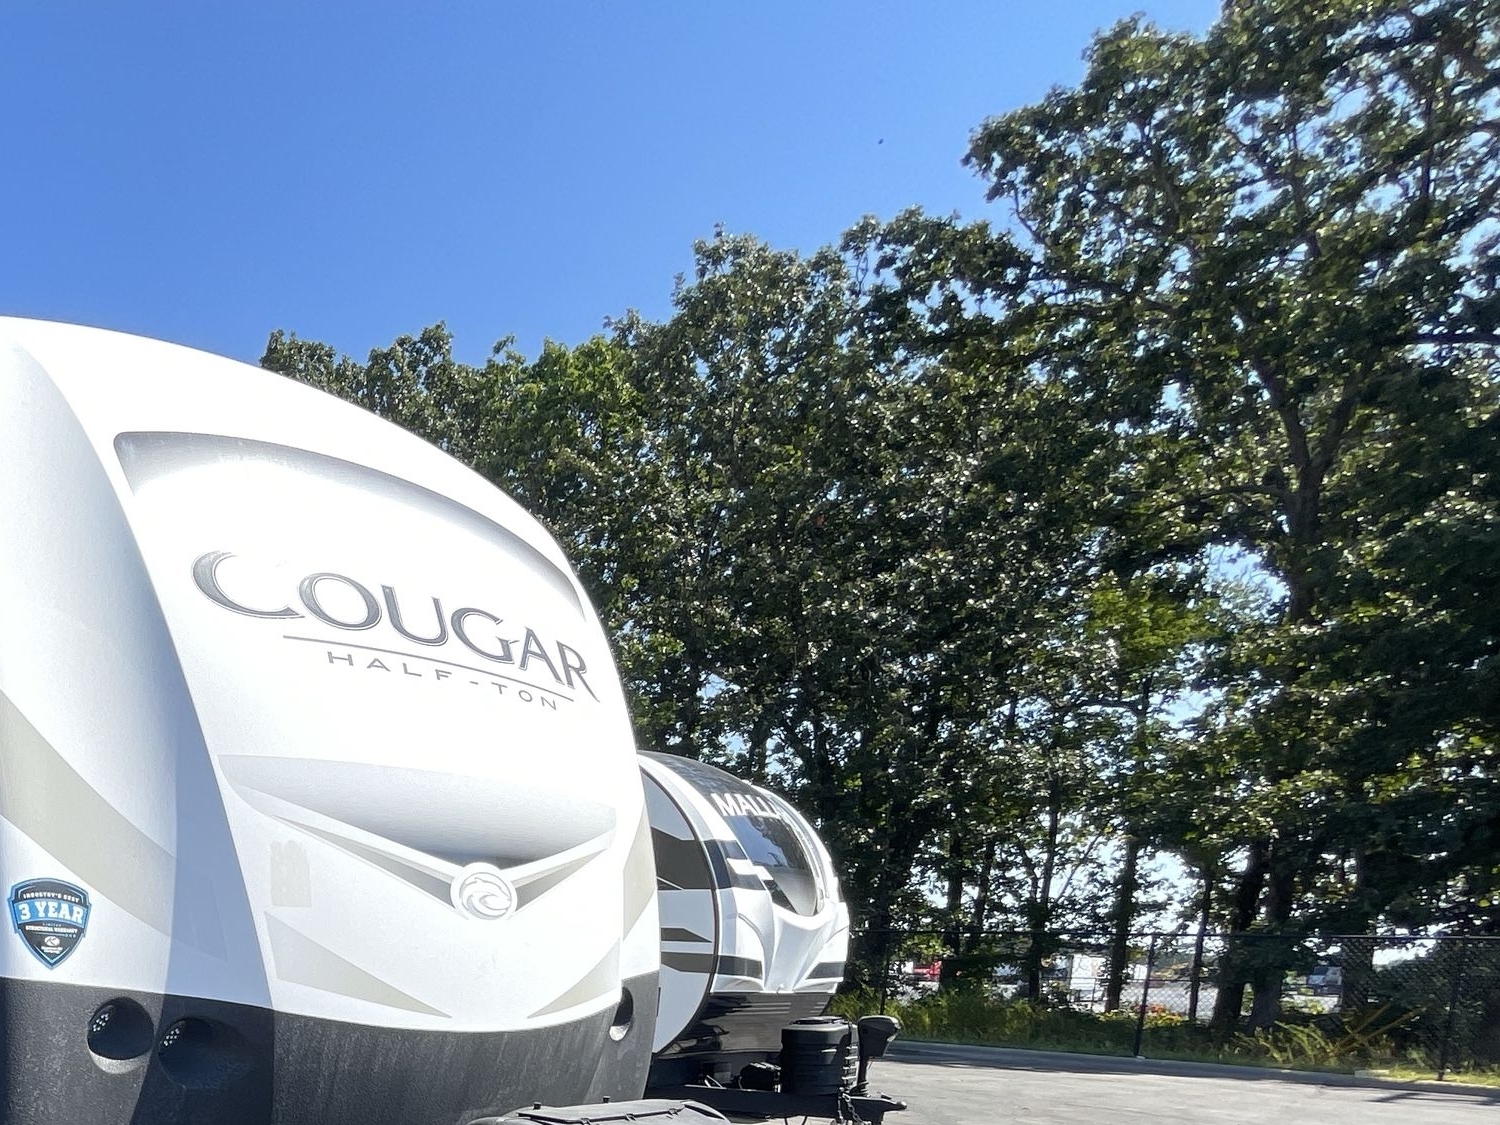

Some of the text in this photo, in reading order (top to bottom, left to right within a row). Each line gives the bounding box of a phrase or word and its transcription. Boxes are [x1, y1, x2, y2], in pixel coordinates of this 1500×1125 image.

[191, 549, 601, 703] COUGAR
[18, 901, 84, 924] 3 YEAR
